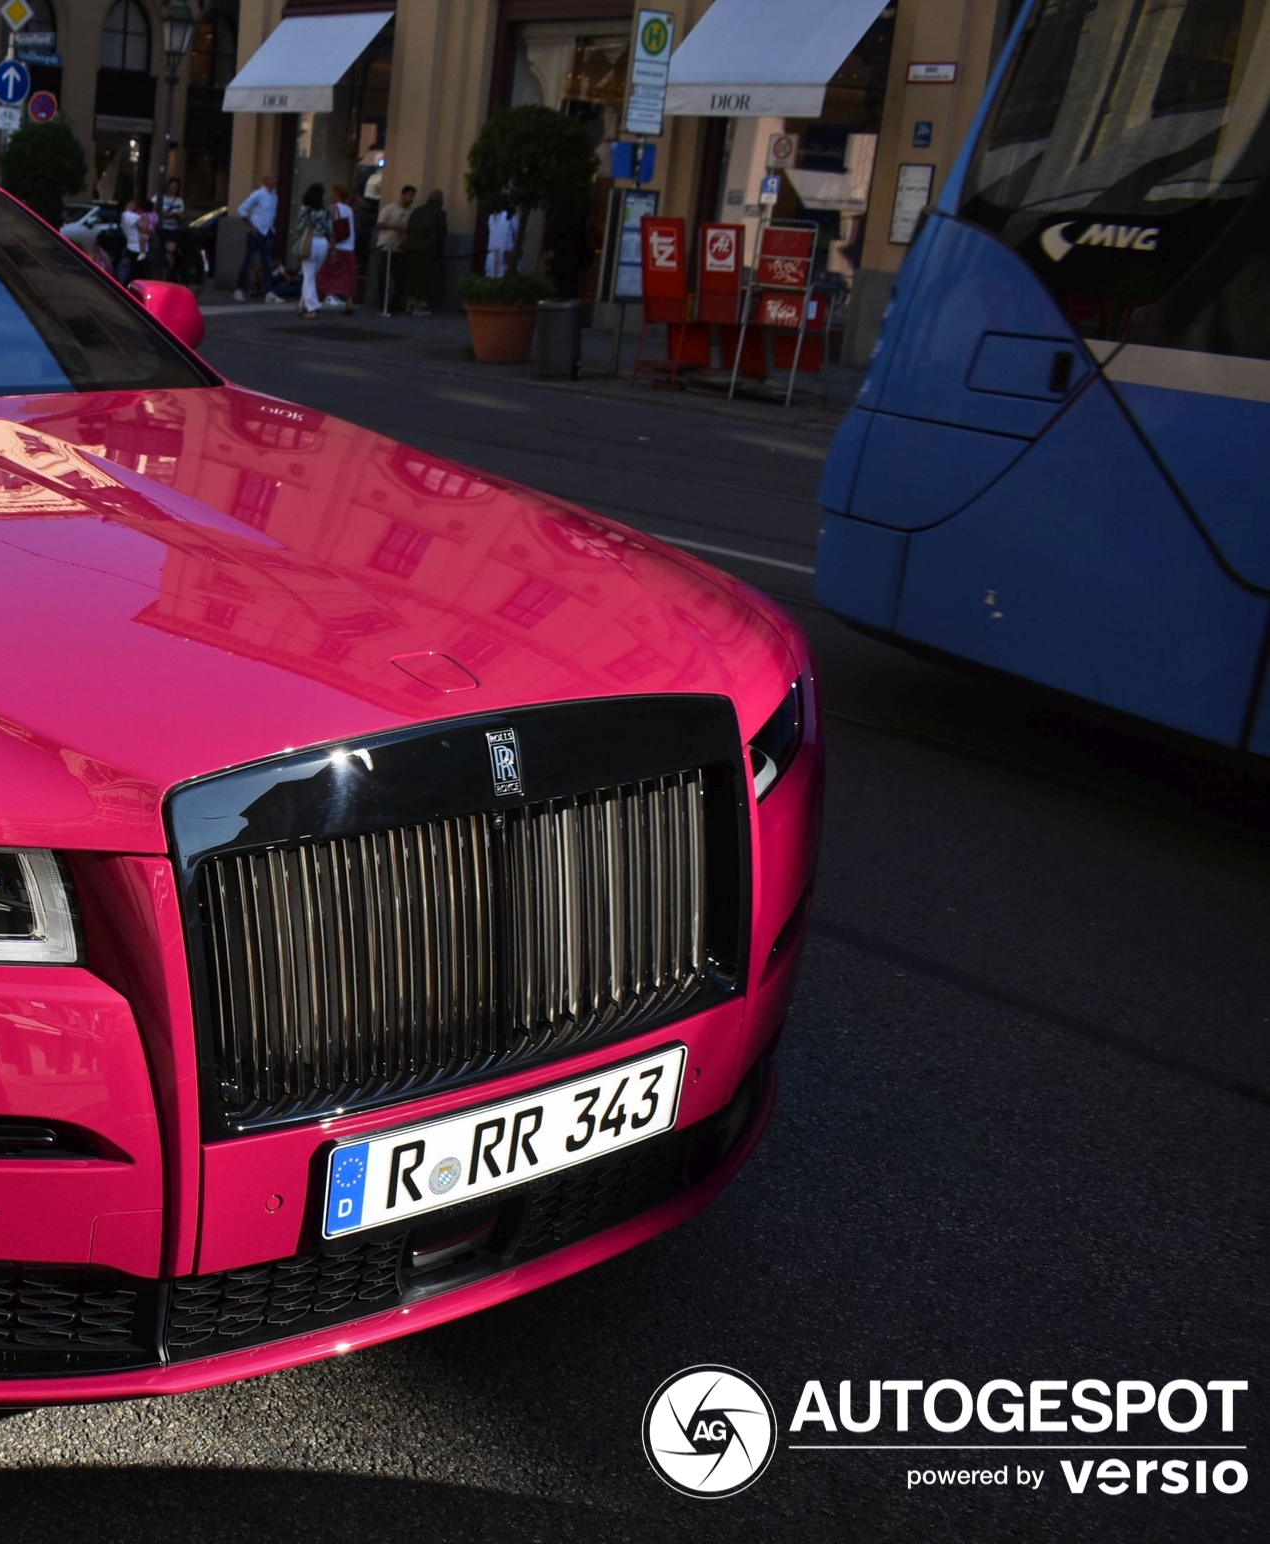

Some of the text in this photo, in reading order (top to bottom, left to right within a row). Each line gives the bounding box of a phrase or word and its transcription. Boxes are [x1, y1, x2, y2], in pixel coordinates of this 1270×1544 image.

[710, 94, 751, 110] DIOR
[1075, 223, 1160, 251] MVG
[489, 732, 513, 743] ROLLS
[496, 782, 520, 794] ROYCE
[337, 1198, 353, 1219] D
[386, 1140, 425, 1209] R
[468, 1106, 543, 1185] RR
[566, 1065, 664, 1152] 343
